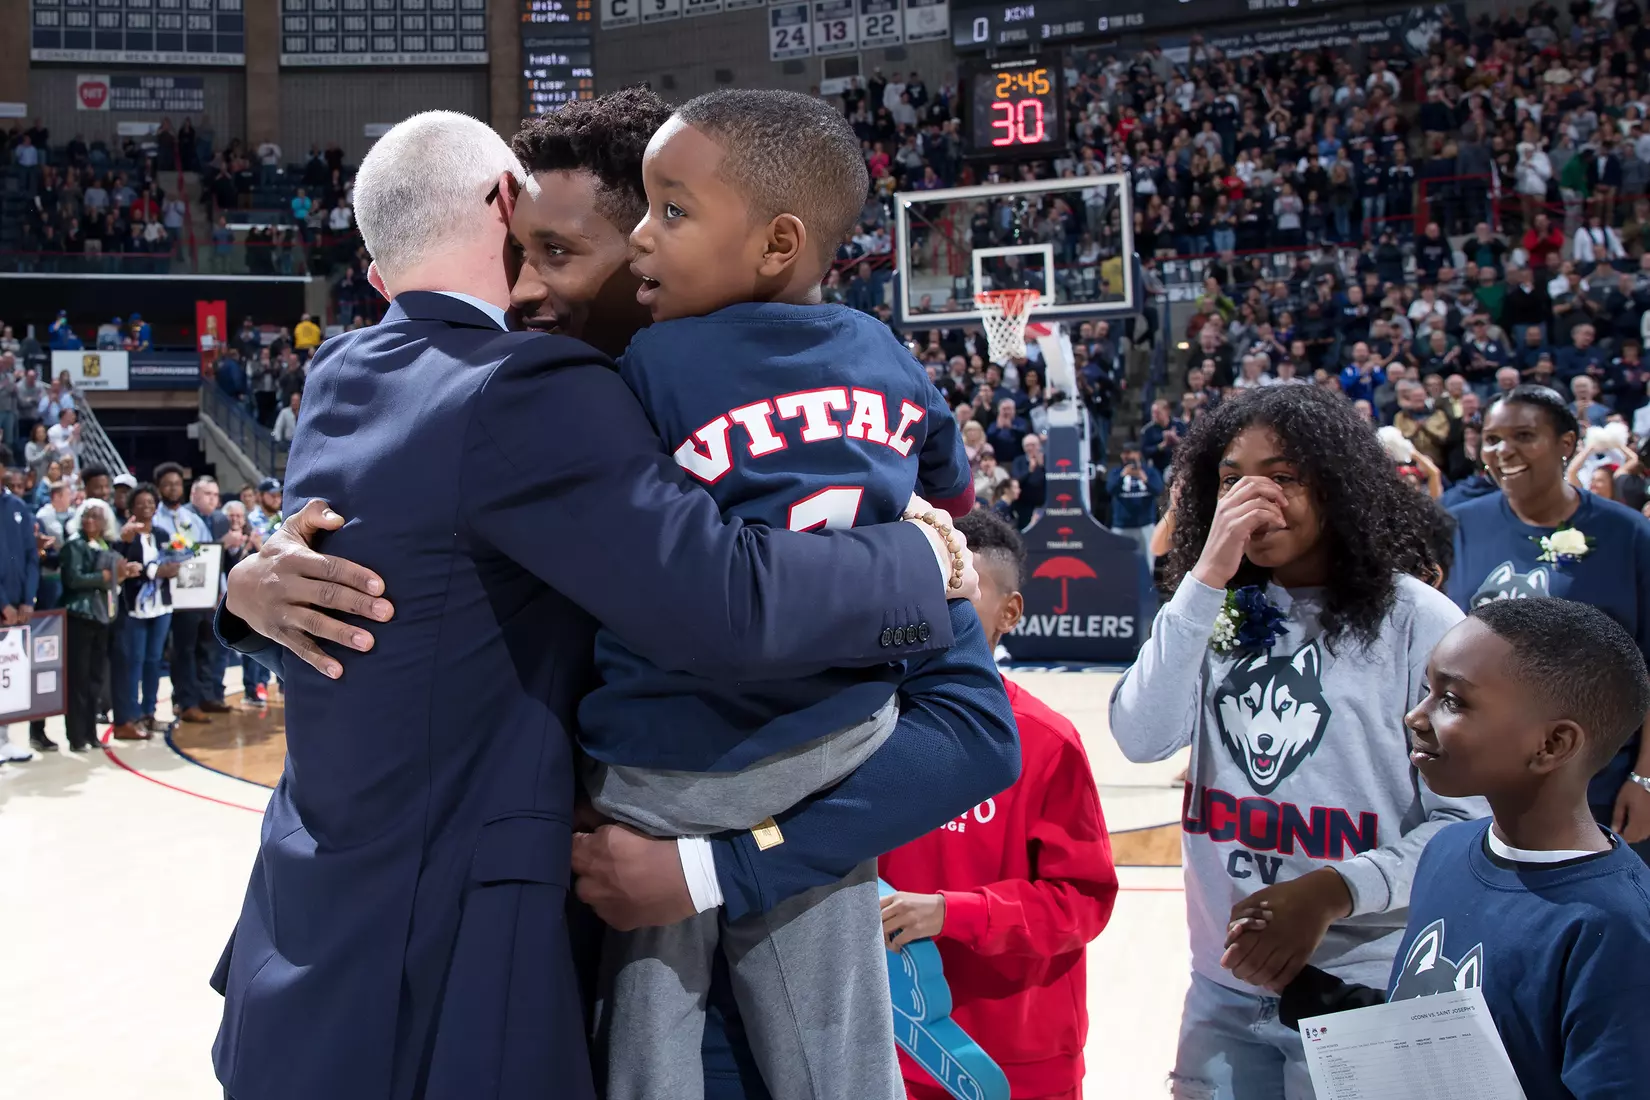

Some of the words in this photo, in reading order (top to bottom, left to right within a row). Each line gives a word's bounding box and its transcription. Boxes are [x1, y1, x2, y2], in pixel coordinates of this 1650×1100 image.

[776, 26, 805, 49] 24
[822, 20, 847, 42] 13
[866, 14, 895, 37] 22
[973, 17, 989, 42] 0
[996, 69, 1050, 98] 2:45
[991, 98, 1044, 146] 30
[673, 386, 926, 485] VITAL
[1012, 615, 1134, 638] RAVELERS
[1183, 780, 1378, 861] UCONN
[1226, 849, 1283, 885] CV
[1411, 1013, 1428, 1021] UCONN
[1452, 1005, 1475, 1014] JOSEPH'S
